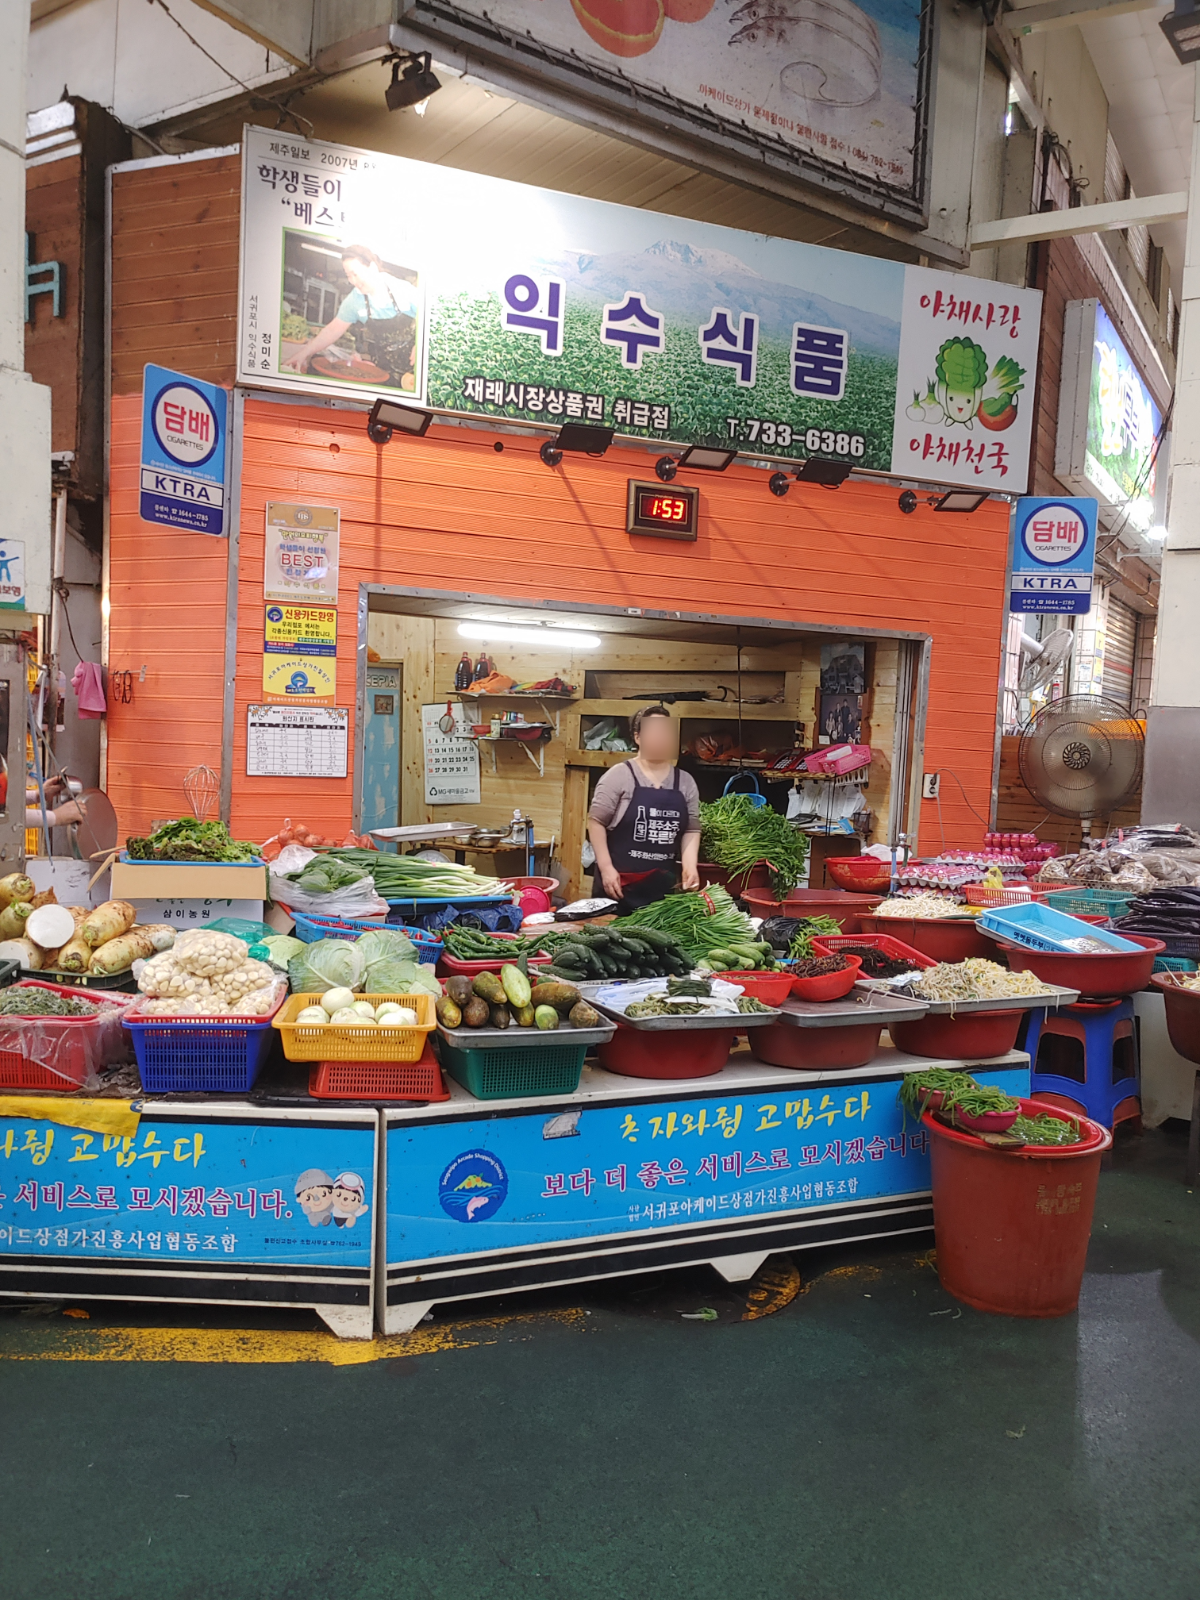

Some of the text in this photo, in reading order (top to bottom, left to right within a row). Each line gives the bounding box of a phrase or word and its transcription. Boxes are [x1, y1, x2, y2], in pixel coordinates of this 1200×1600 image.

[269, 142, 311, 160] 제주일보
[320, 152, 358, 171] 2007년
[257, 163, 342, 202] 학생들이
[249, 294, 258, 330] 서귀포시
[919, 290, 1021, 338] 야채사랑
[260, 332, 272, 370] 정미순
[163, 401, 210, 443] 담배
[464, 377, 669, 430] 재래시장상품권 취급점
[166, 435, 204, 451] CIGARETTES
[726, 418, 865, 457] T.733-6386
[909, 433, 1010, 478] 야채천국
[155, 475, 211, 501] KTRA
[652, 499, 685, 519] 1:53
[1032, 521, 1079, 544] 담배
[281, 553, 324, 567] BEST
[1023, 577, 1078, 589] KTRA
[285, 609, 335, 623] 신용카드환영
[163, 909, 211, 918] 삼이농원
[754, 1091, 872, 1132] 고맙수다
[68, 1131, 207, 1169] 고맙수다
[457, 1153, 474, 1164] Arcade
[474, 1153, 496, 1166] Shopping
[493, 1162, 504, 1180] District
[541, 1168, 596, 1198] 보다
[604, 1163, 627, 1193] 더
[637, 1158, 688, 1189] 좋은
[695, 1148, 792, 1181] 서비스로
[13, 1180, 294, 1220] 서비스로 모시겠습니다.
[642, 1177, 859, 1221] 서귀포아케이드상점가진흥사업협동조합
